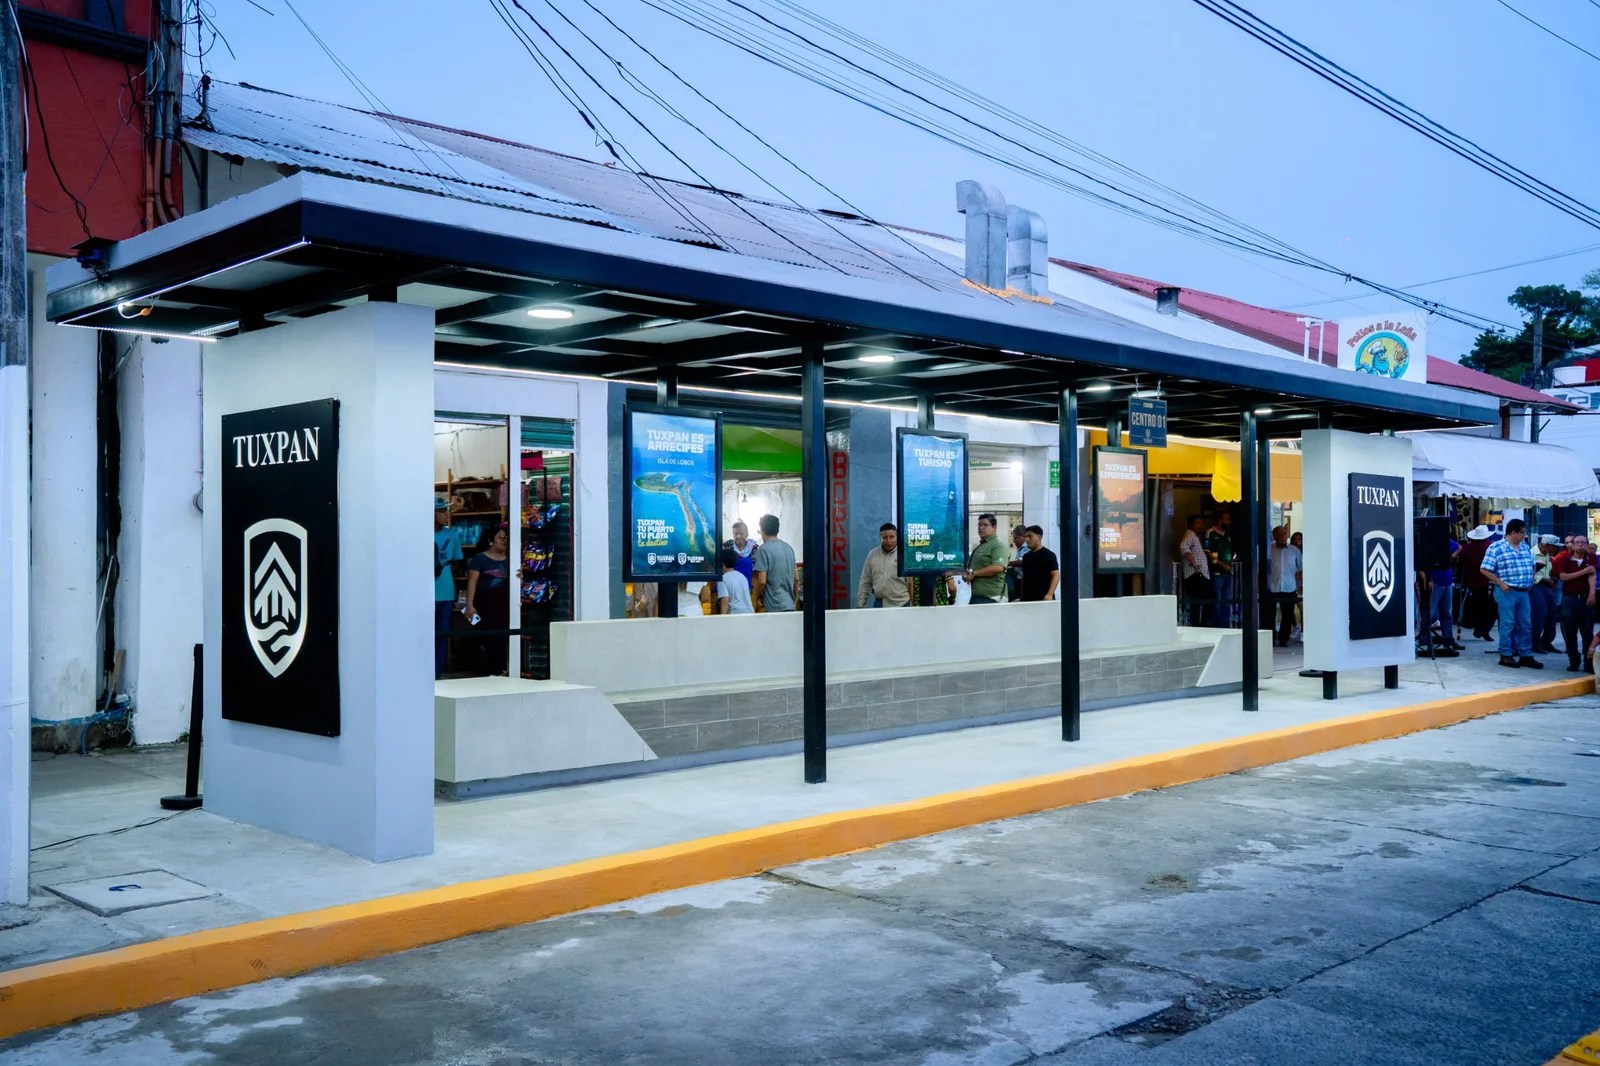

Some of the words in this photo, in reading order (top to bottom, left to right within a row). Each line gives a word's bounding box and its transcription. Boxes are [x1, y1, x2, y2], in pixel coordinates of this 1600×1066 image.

[1347, 325, 1375, 348] Pollos
[1376, 322, 1382, 330] a
[1384, 320, 1394, 330] la
[1395, 322, 1418, 341] Leña
[1132, 412, 1156, 428] CENTRO
[1158, 414, 1166, 428] 01
[647, 429, 688, 442] TUXPAN
[690, 433, 704, 443] ES
[232, 427, 320, 468] TUXPAN
[648, 440, 704, 454] ARRECIFES
[914, 449, 944, 458] TUXPAN
[946, 450, 956, 460] ES
[918, 458, 952, 468] TURISMO
[1104, 464, 1128, 472] TUXPAN
[1356, 486, 1399, 508] TUXPAN
